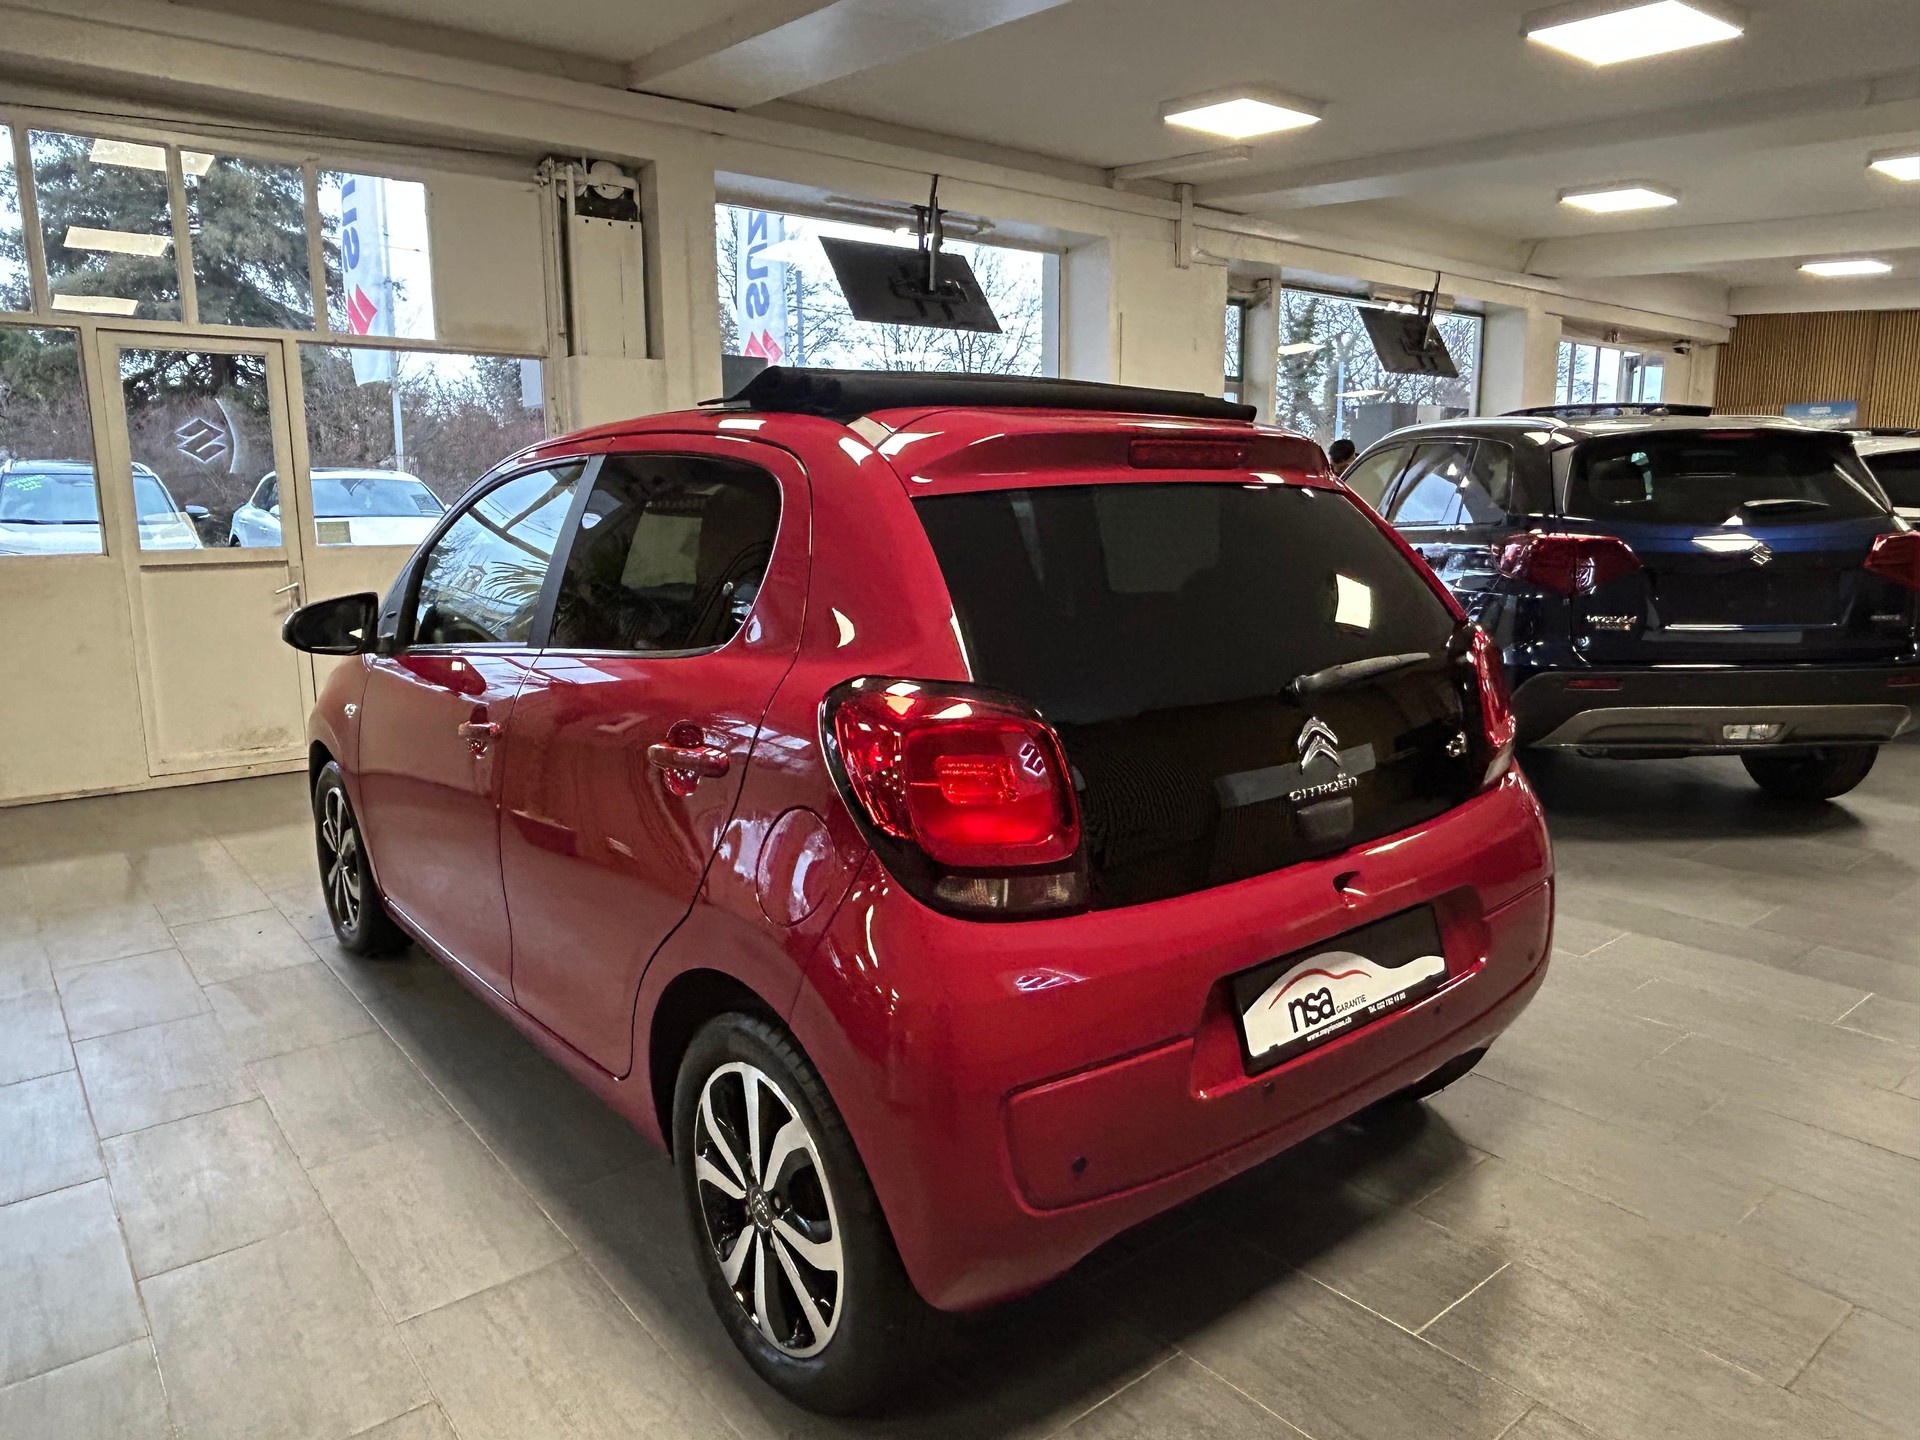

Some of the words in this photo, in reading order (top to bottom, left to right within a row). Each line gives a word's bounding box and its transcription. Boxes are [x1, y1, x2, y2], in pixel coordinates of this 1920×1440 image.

[1289, 772, 1358, 802] CITROËN
[1287, 986, 1337, 1034] nsa
[1336, 994, 1368, 1014] GARANTIE
